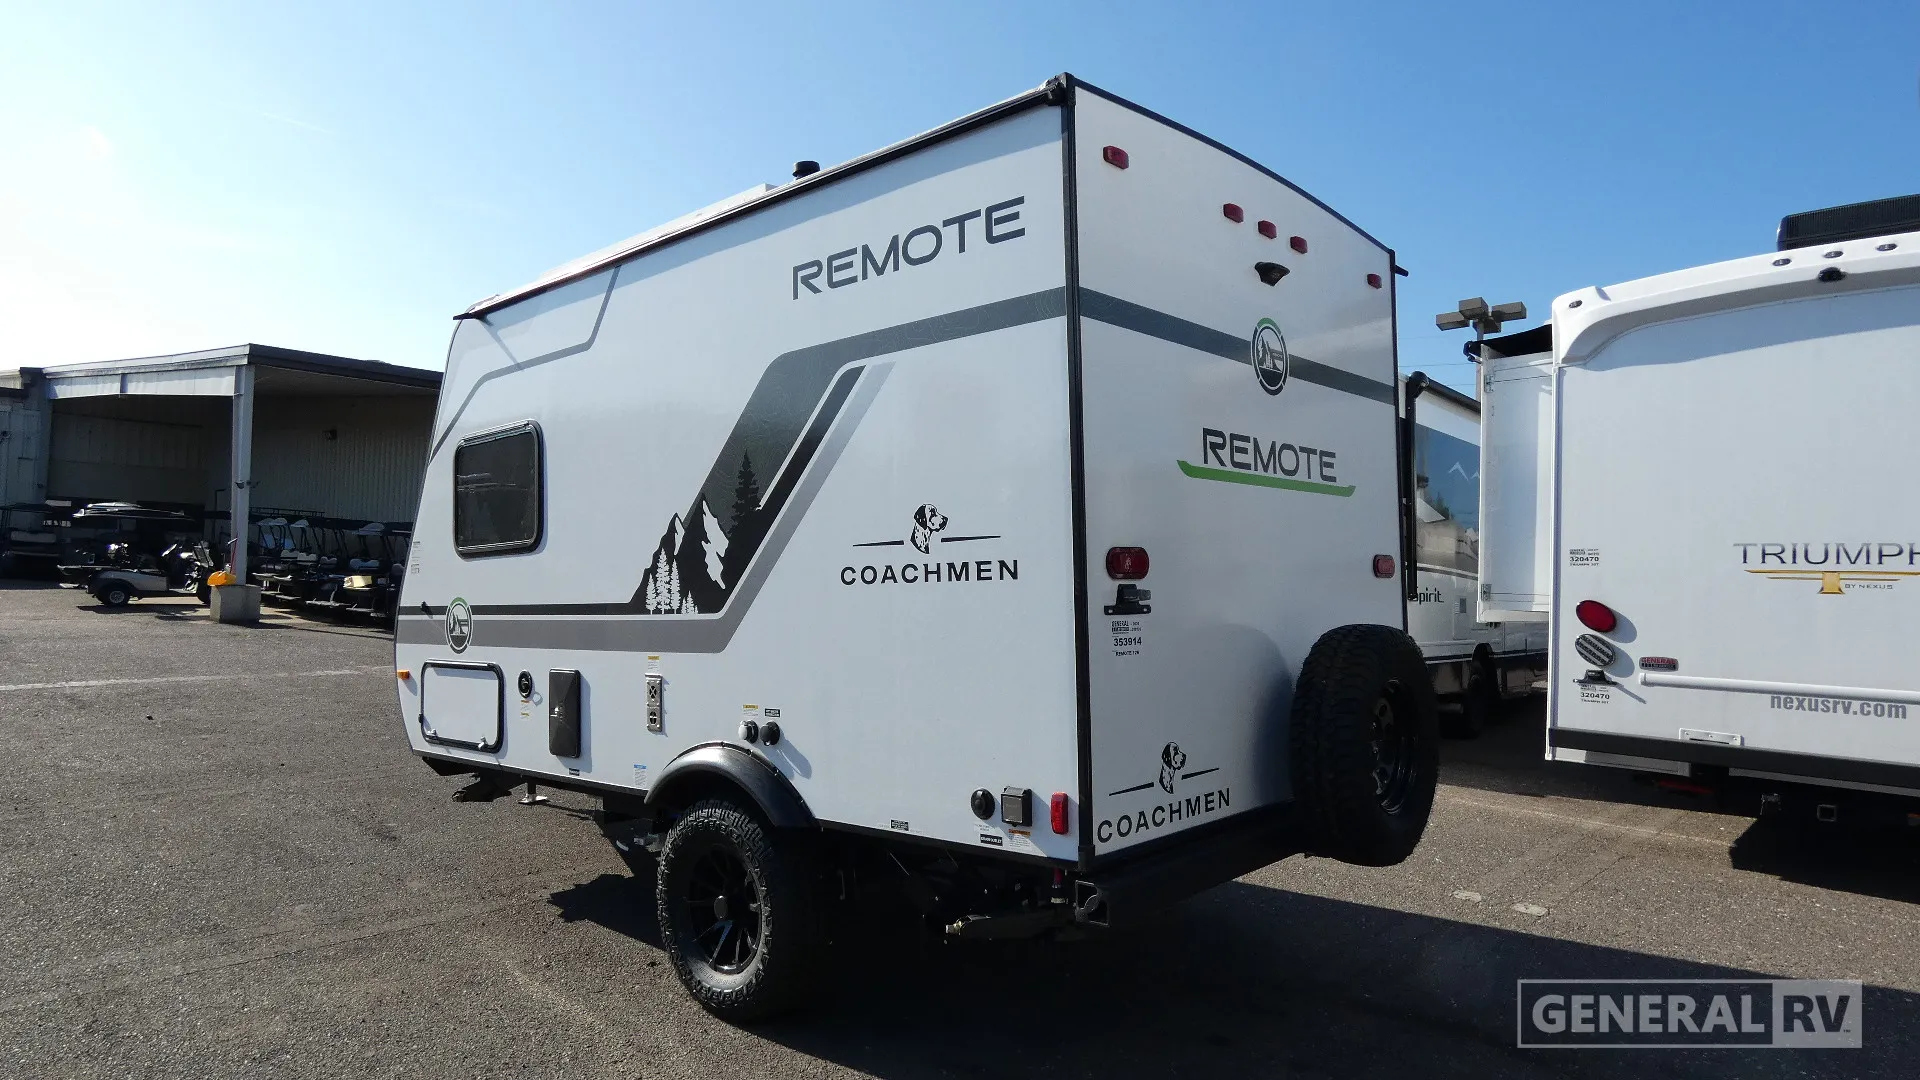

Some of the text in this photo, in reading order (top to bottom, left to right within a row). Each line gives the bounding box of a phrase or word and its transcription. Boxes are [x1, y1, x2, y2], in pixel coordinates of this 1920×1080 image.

[793, 195, 1026, 300] REMOTE
[1202, 427, 1337, 483] REMOTE
[840, 559, 1019, 586] COACHMEN
[1113, 636, 1142, 647] 353914
[1580, 691, 1610, 700] 320470
[1770, 694, 1907, 720] nexusrv.com
[1097, 787, 1230, 844] COACHMEN
